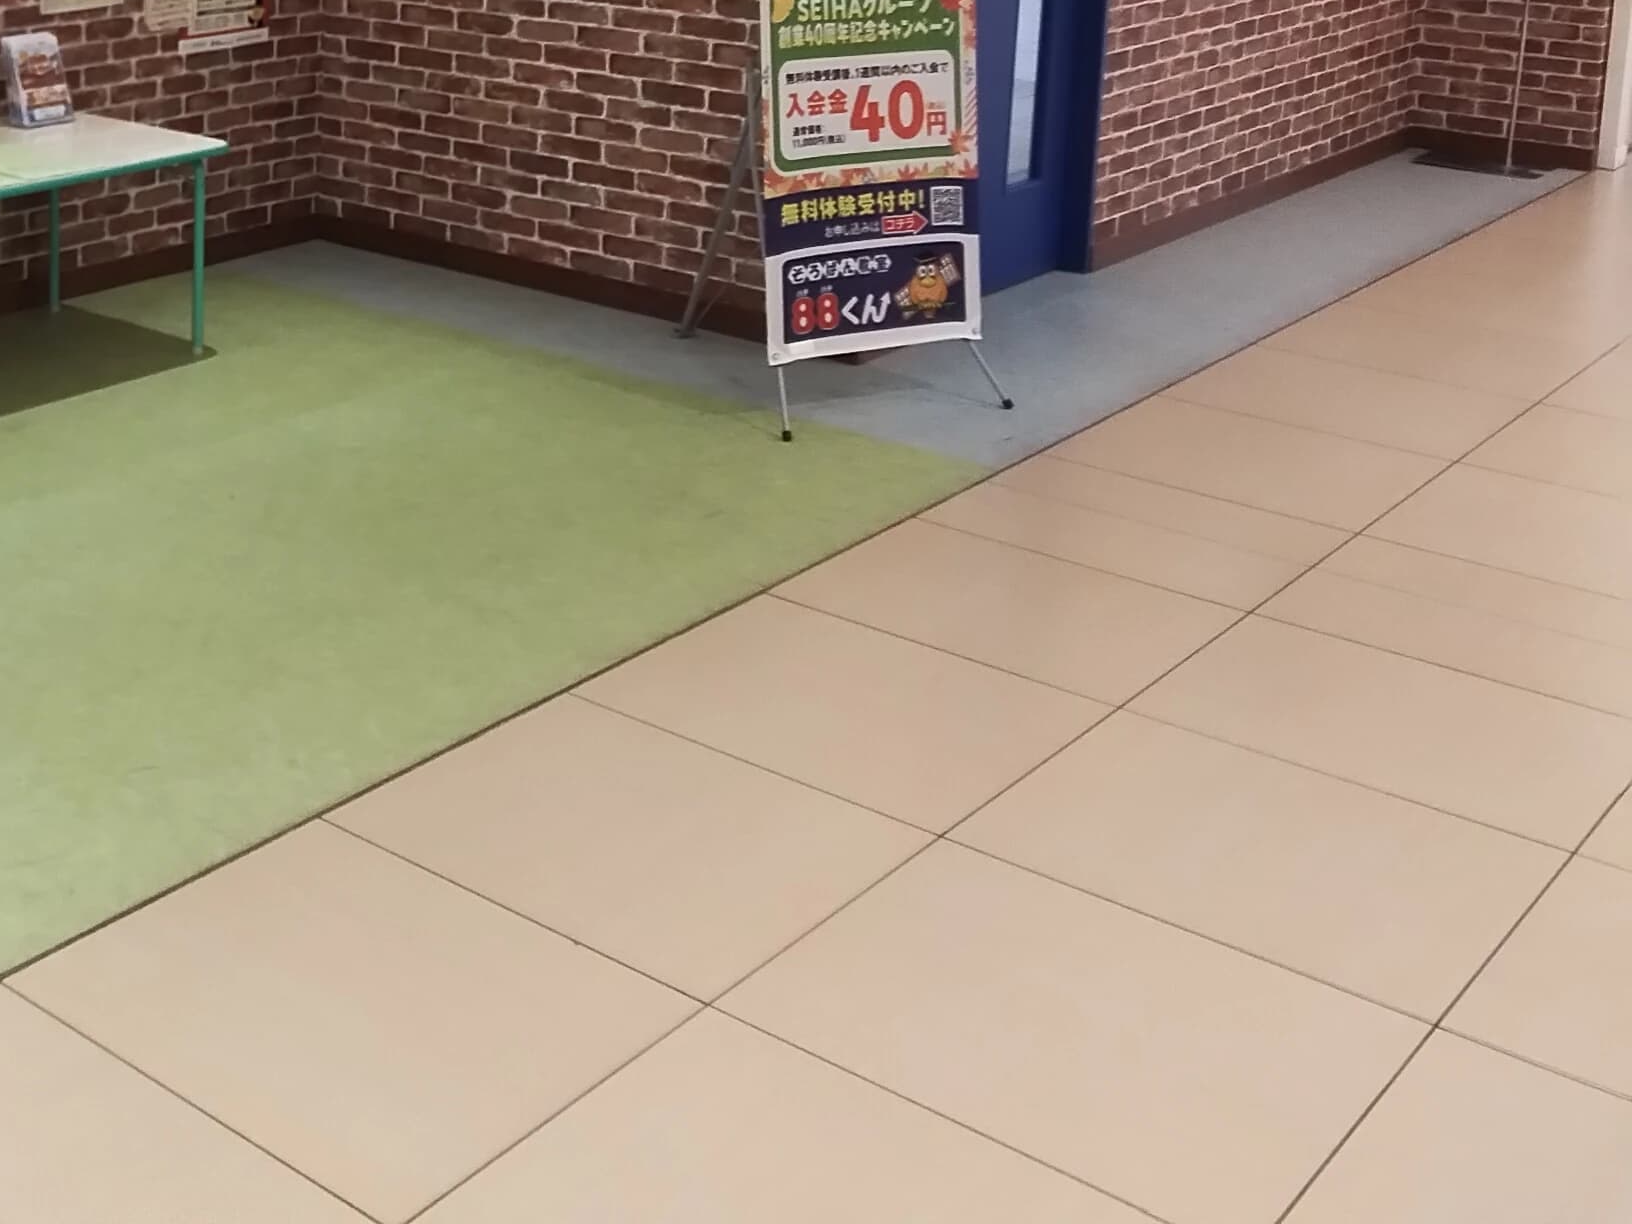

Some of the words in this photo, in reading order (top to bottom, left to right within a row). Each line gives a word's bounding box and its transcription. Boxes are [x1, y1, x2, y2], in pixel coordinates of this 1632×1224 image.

[778, 16, 954, 49] 創業40周年記念キャンペーン
[886, 218, 917, 231] コチラ
[791, 291, 892, 335] 88くん
